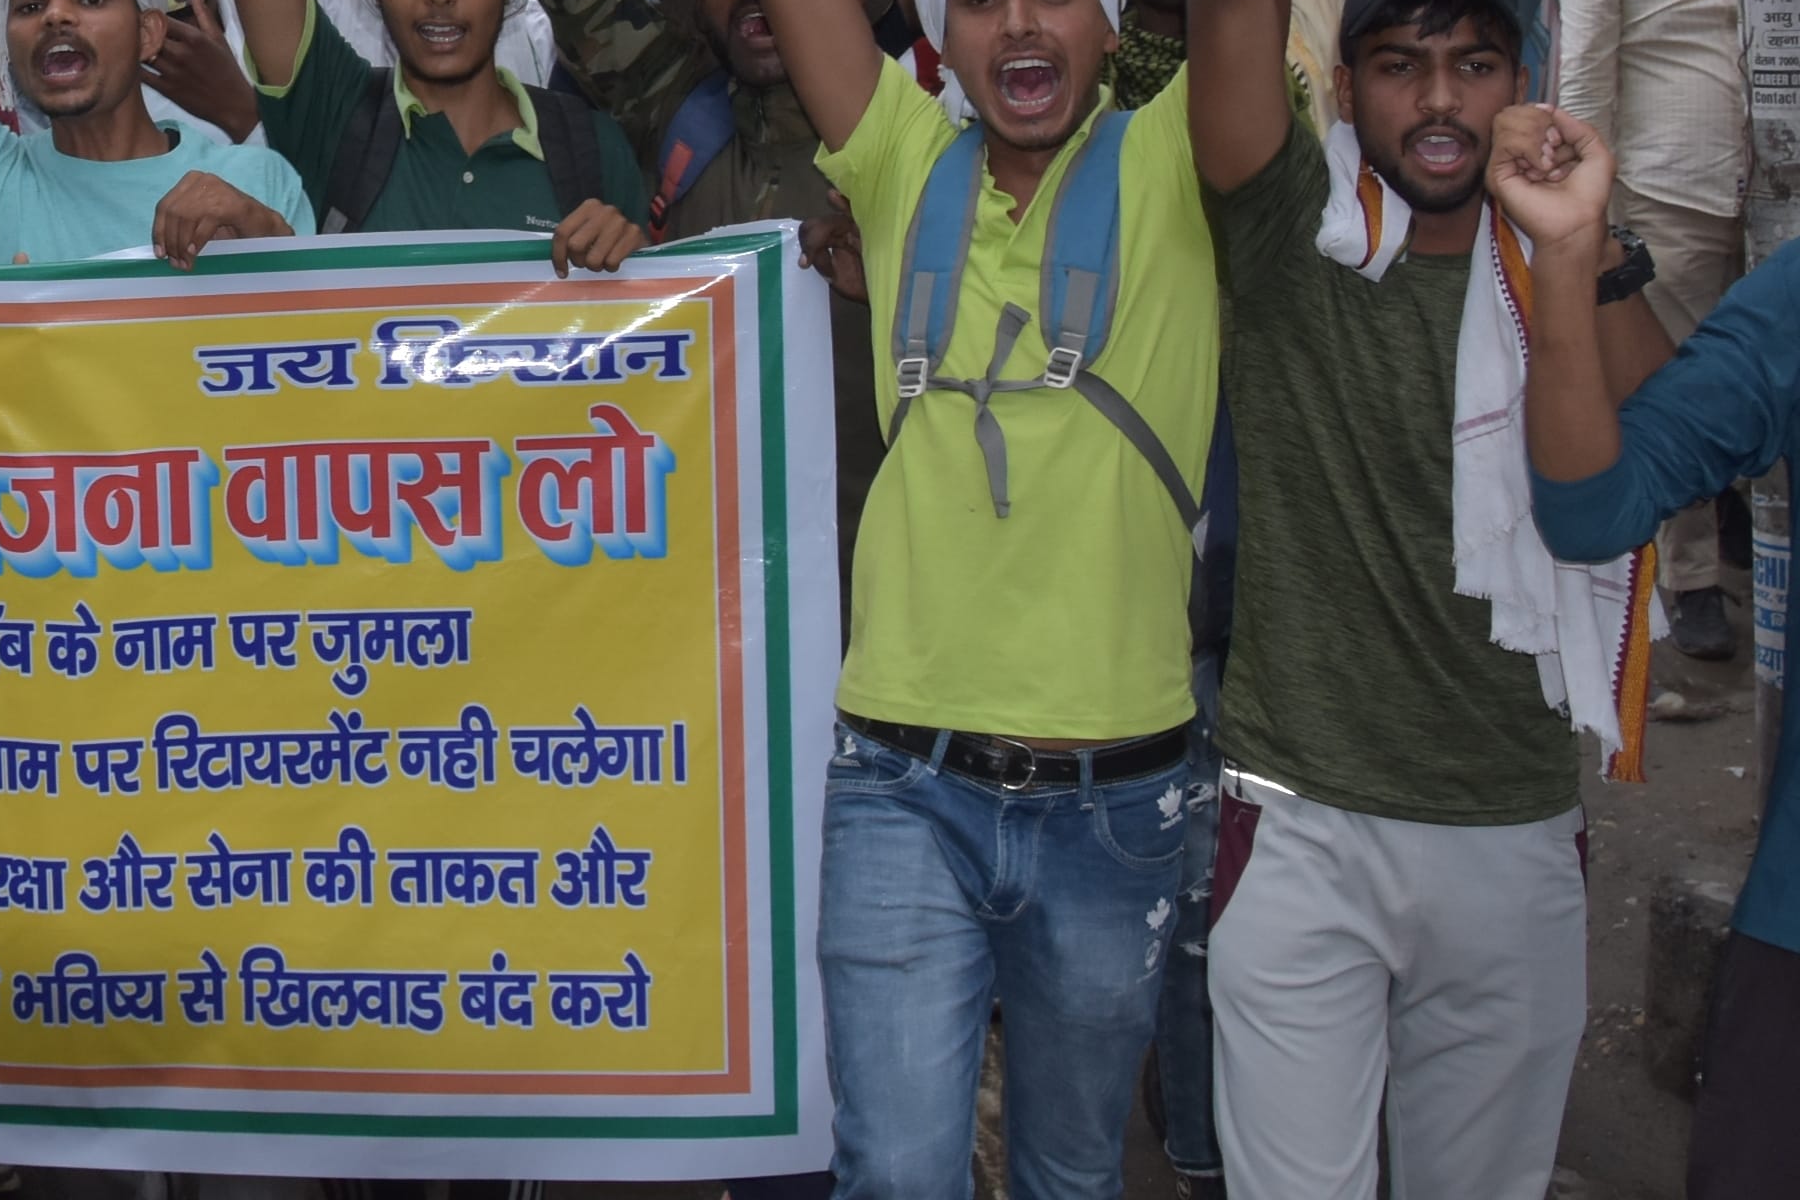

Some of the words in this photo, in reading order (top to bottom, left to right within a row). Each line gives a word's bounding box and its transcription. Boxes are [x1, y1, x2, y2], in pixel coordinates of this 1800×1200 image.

[1763, 12, 1793, 28] आयु
[1754, 91, 1798, 105] Contact
[198, 341, 358, 393] जय
[376, 318, 692, 388] किसान
[225, 439, 502, 562] वापस
[515, 402, 666, 558] लो
[45, 602, 102, 677] के
[113, 616, 217, 673] नाम
[228, 613, 301, 668] पर
[307, 609, 473, 696] जुमला
[71, 738, 144, 795] पर
[152, 711, 391, 792] रिटायरमेंट
[397, 704, 499, 791] नही
[78, 832, 178, 913] और
[185, 830, 294, 910] सेना
[303, 825, 376, 908] की
[386, 848, 541, 907] ताकत
[550, 824, 653, 909] और
[11, 951, 167, 1026] भविष्य
[176, 948, 229, 1026] से
[238, 944, 448, 1036] खिलवाड
[457, 949, 538, 1029] बंद
[547, 949, 653, 1030] करो
